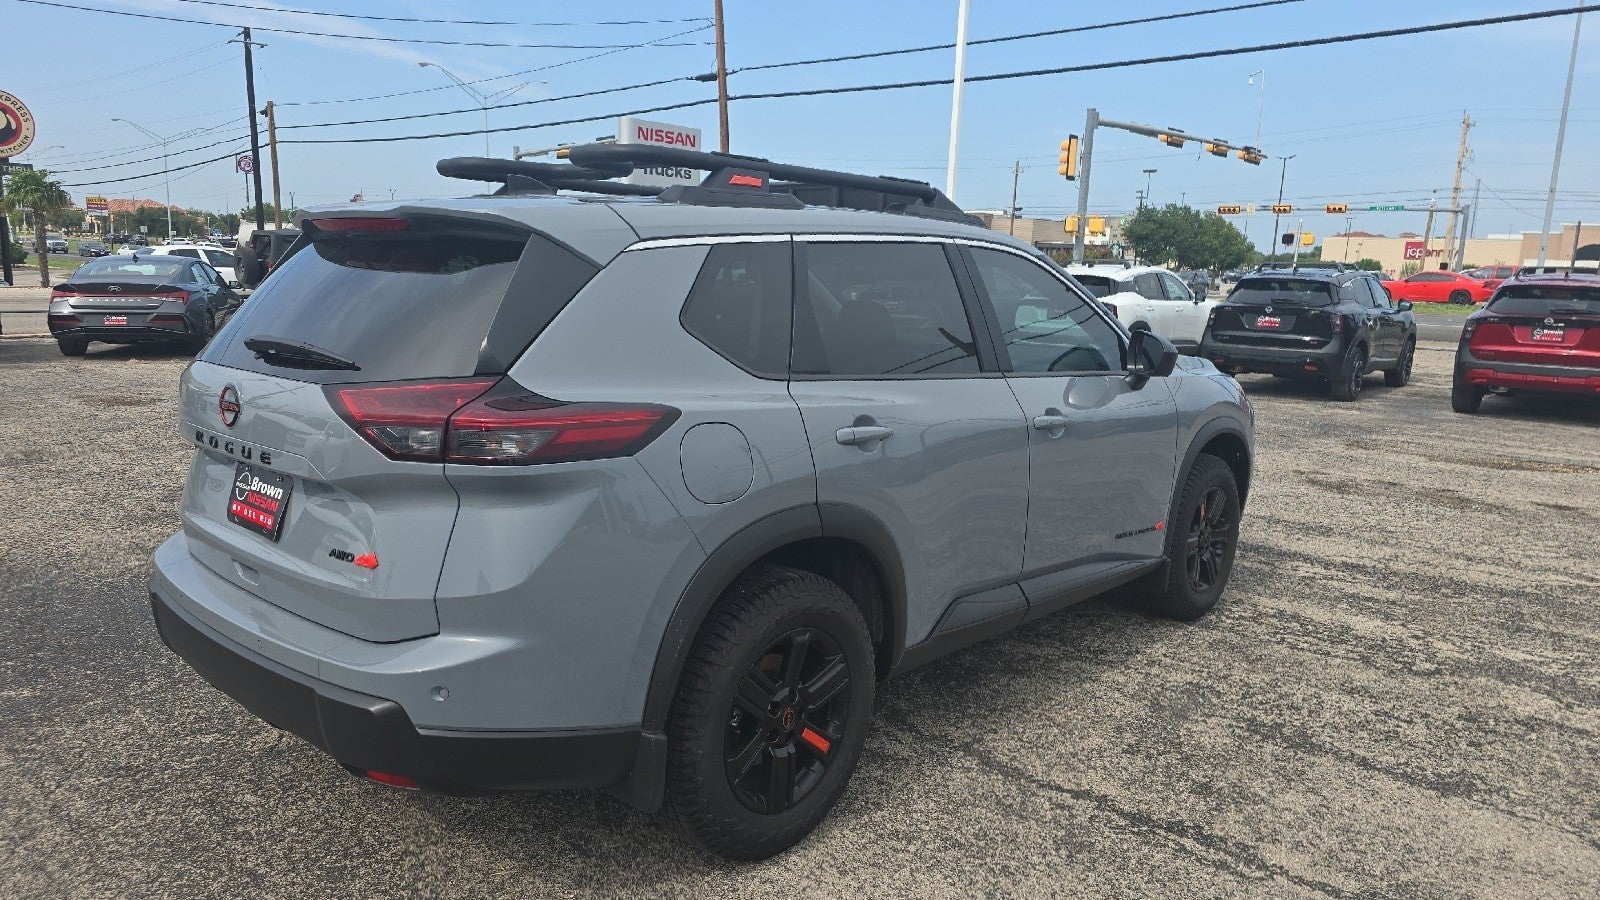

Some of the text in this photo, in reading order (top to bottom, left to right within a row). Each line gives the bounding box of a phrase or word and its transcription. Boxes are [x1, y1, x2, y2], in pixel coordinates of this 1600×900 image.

[0, 135, 30, 155] KITCHEN
[637, 126, 696, 148] NISSAN
[195, 430, 272, 465] ROGUE
[250, 476, 284, 500] Brown
[247, 491, 280, 512] NISSAN
[243, 507, 257, 520] DEL
[259, 514, 273, 526] RIO
[328, 547, 355, 563] AWD
